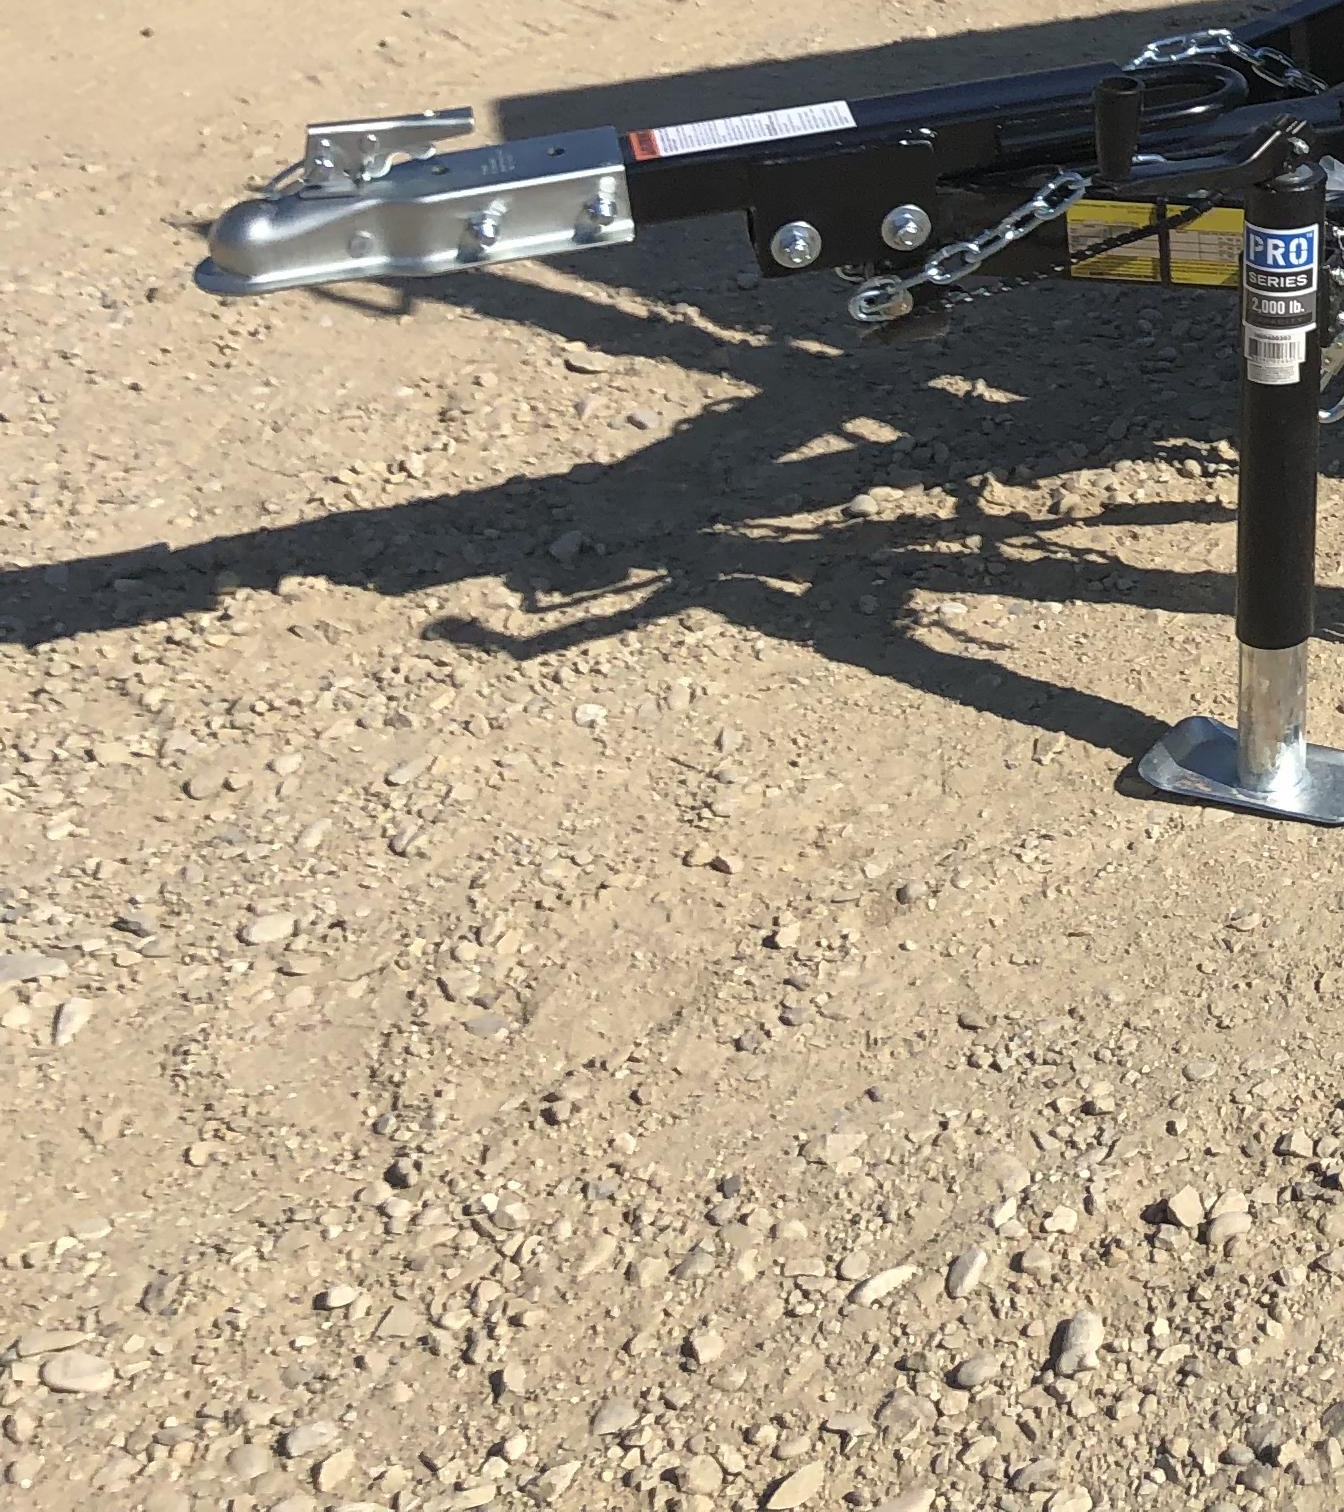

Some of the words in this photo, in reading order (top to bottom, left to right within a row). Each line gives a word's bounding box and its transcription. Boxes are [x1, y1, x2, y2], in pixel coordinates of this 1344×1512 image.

[1249, 233, 1309, 267] PRO
[1248, 271, 1309, 288] SERIES
[1251, 297, 1286, 315] 2,000
[1288, 300, 1305, 314] lb.
